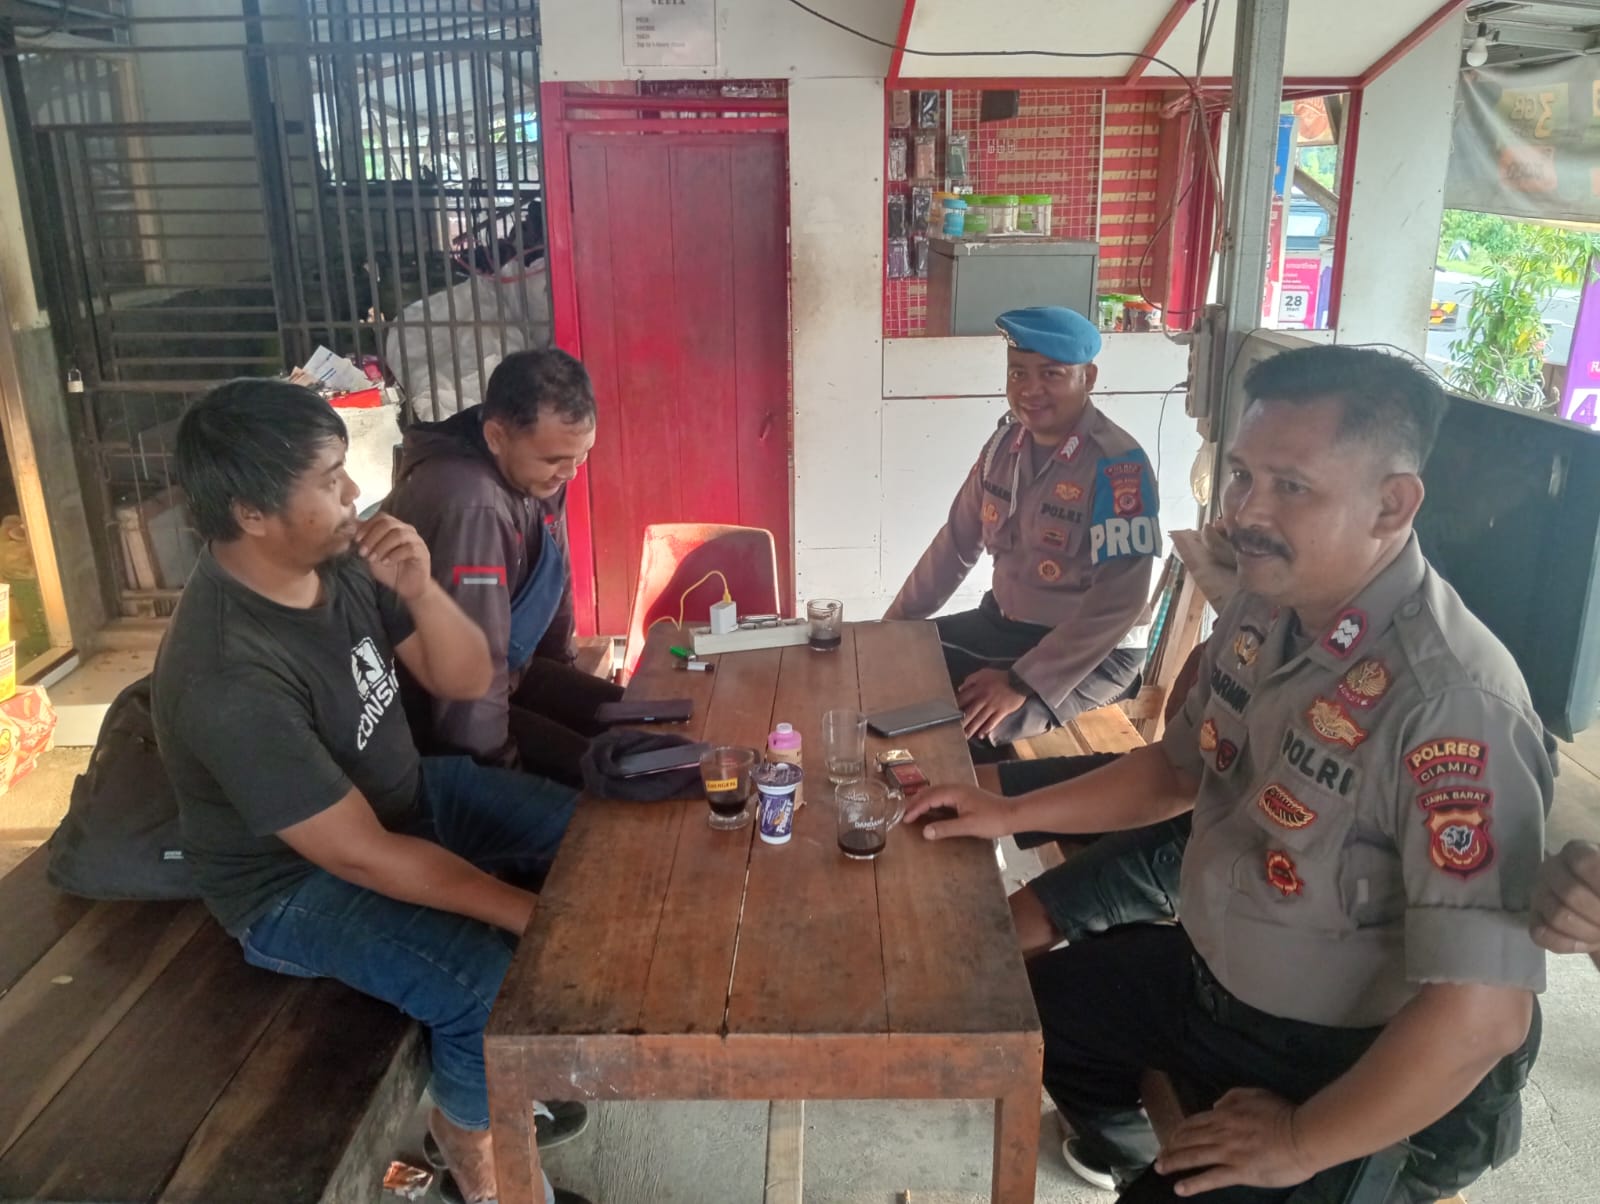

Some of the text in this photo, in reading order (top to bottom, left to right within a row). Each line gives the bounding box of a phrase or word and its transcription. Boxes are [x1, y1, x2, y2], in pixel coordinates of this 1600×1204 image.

[1285, 295, 1303, 306] 28
[1041, 502, 1083, 524] POLRI
[1411, 741, 1481, 768] POLRES
[1420, 761, 1478, 782] CIAMIS
[1424, 791, 1486, 806] JAWA BARAT
